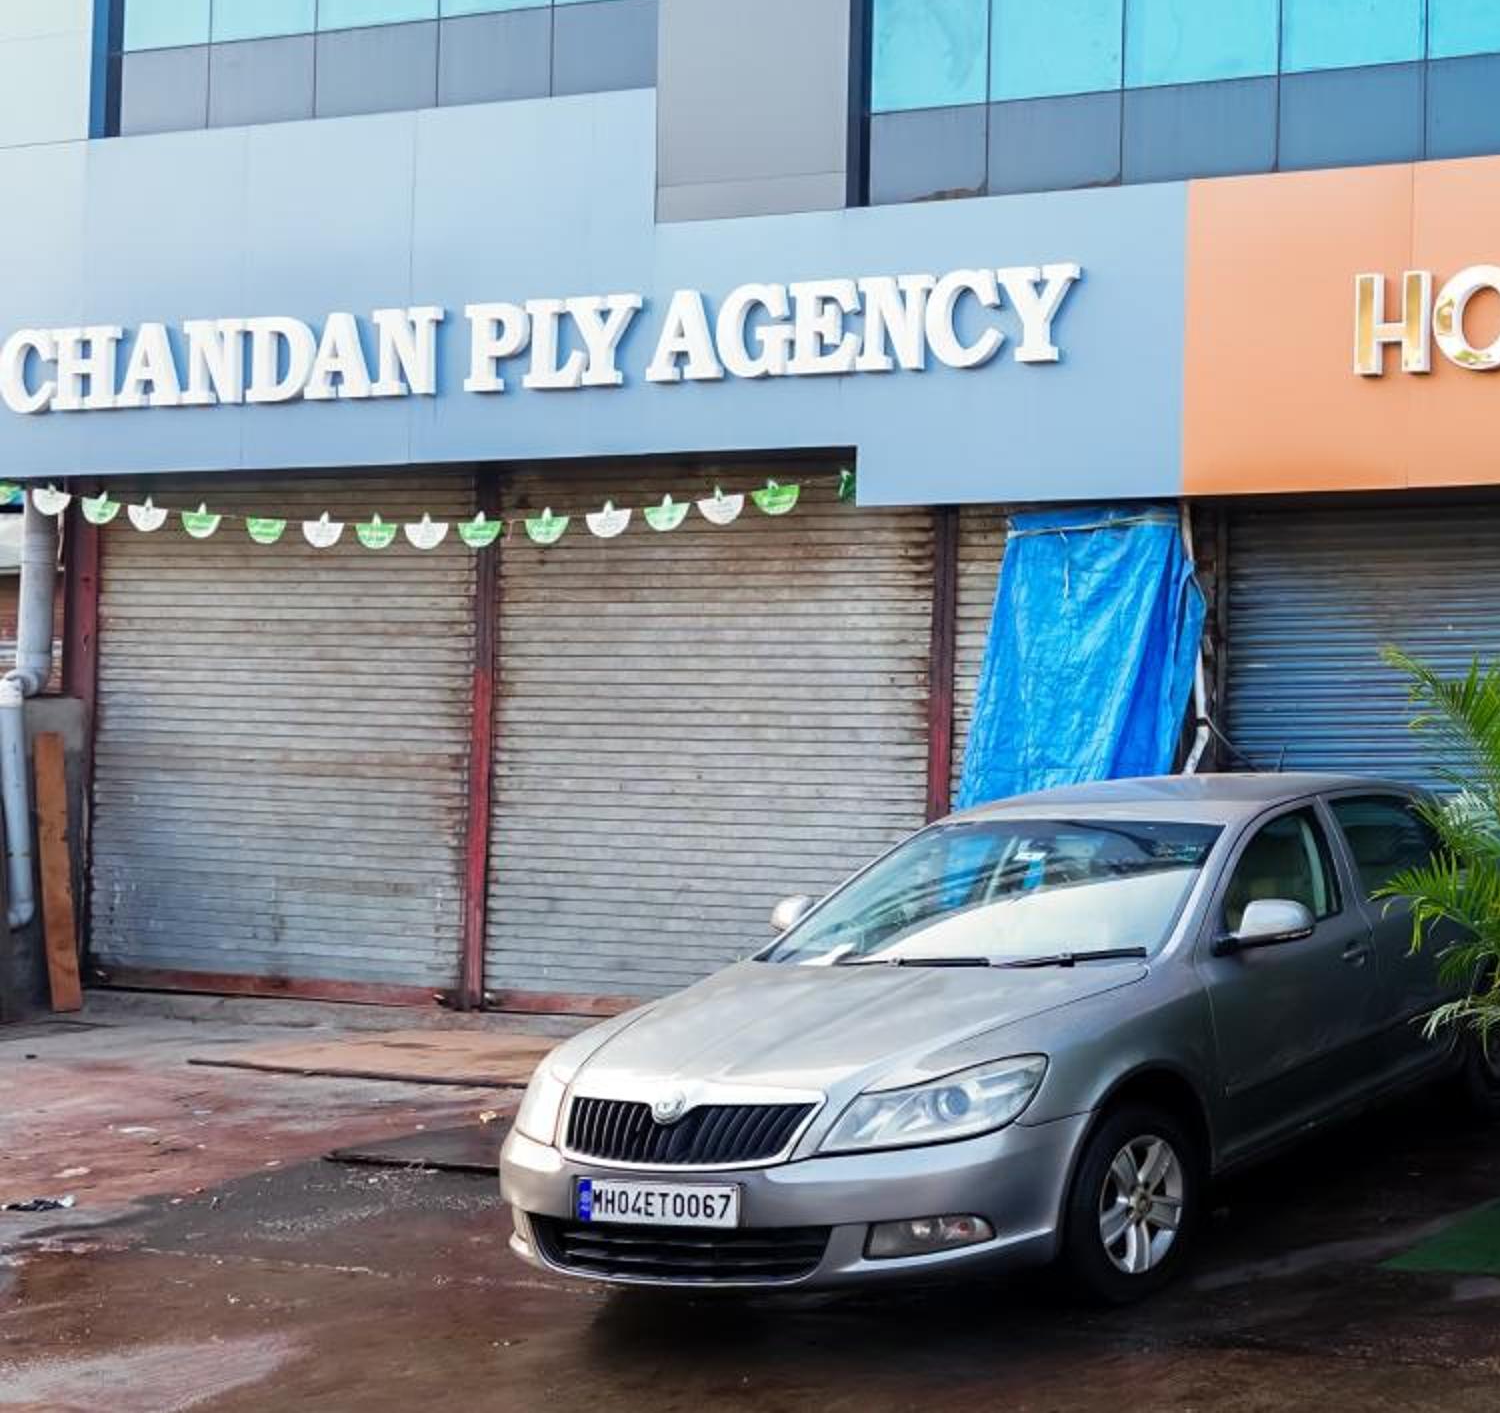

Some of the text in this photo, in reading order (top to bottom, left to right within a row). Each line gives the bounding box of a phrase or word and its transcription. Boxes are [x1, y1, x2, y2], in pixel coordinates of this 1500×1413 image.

[0, 262, 1083, 416] CHANDAN PLY AGENCY
[592, 1189, 732, 1220] MH04ET0067
